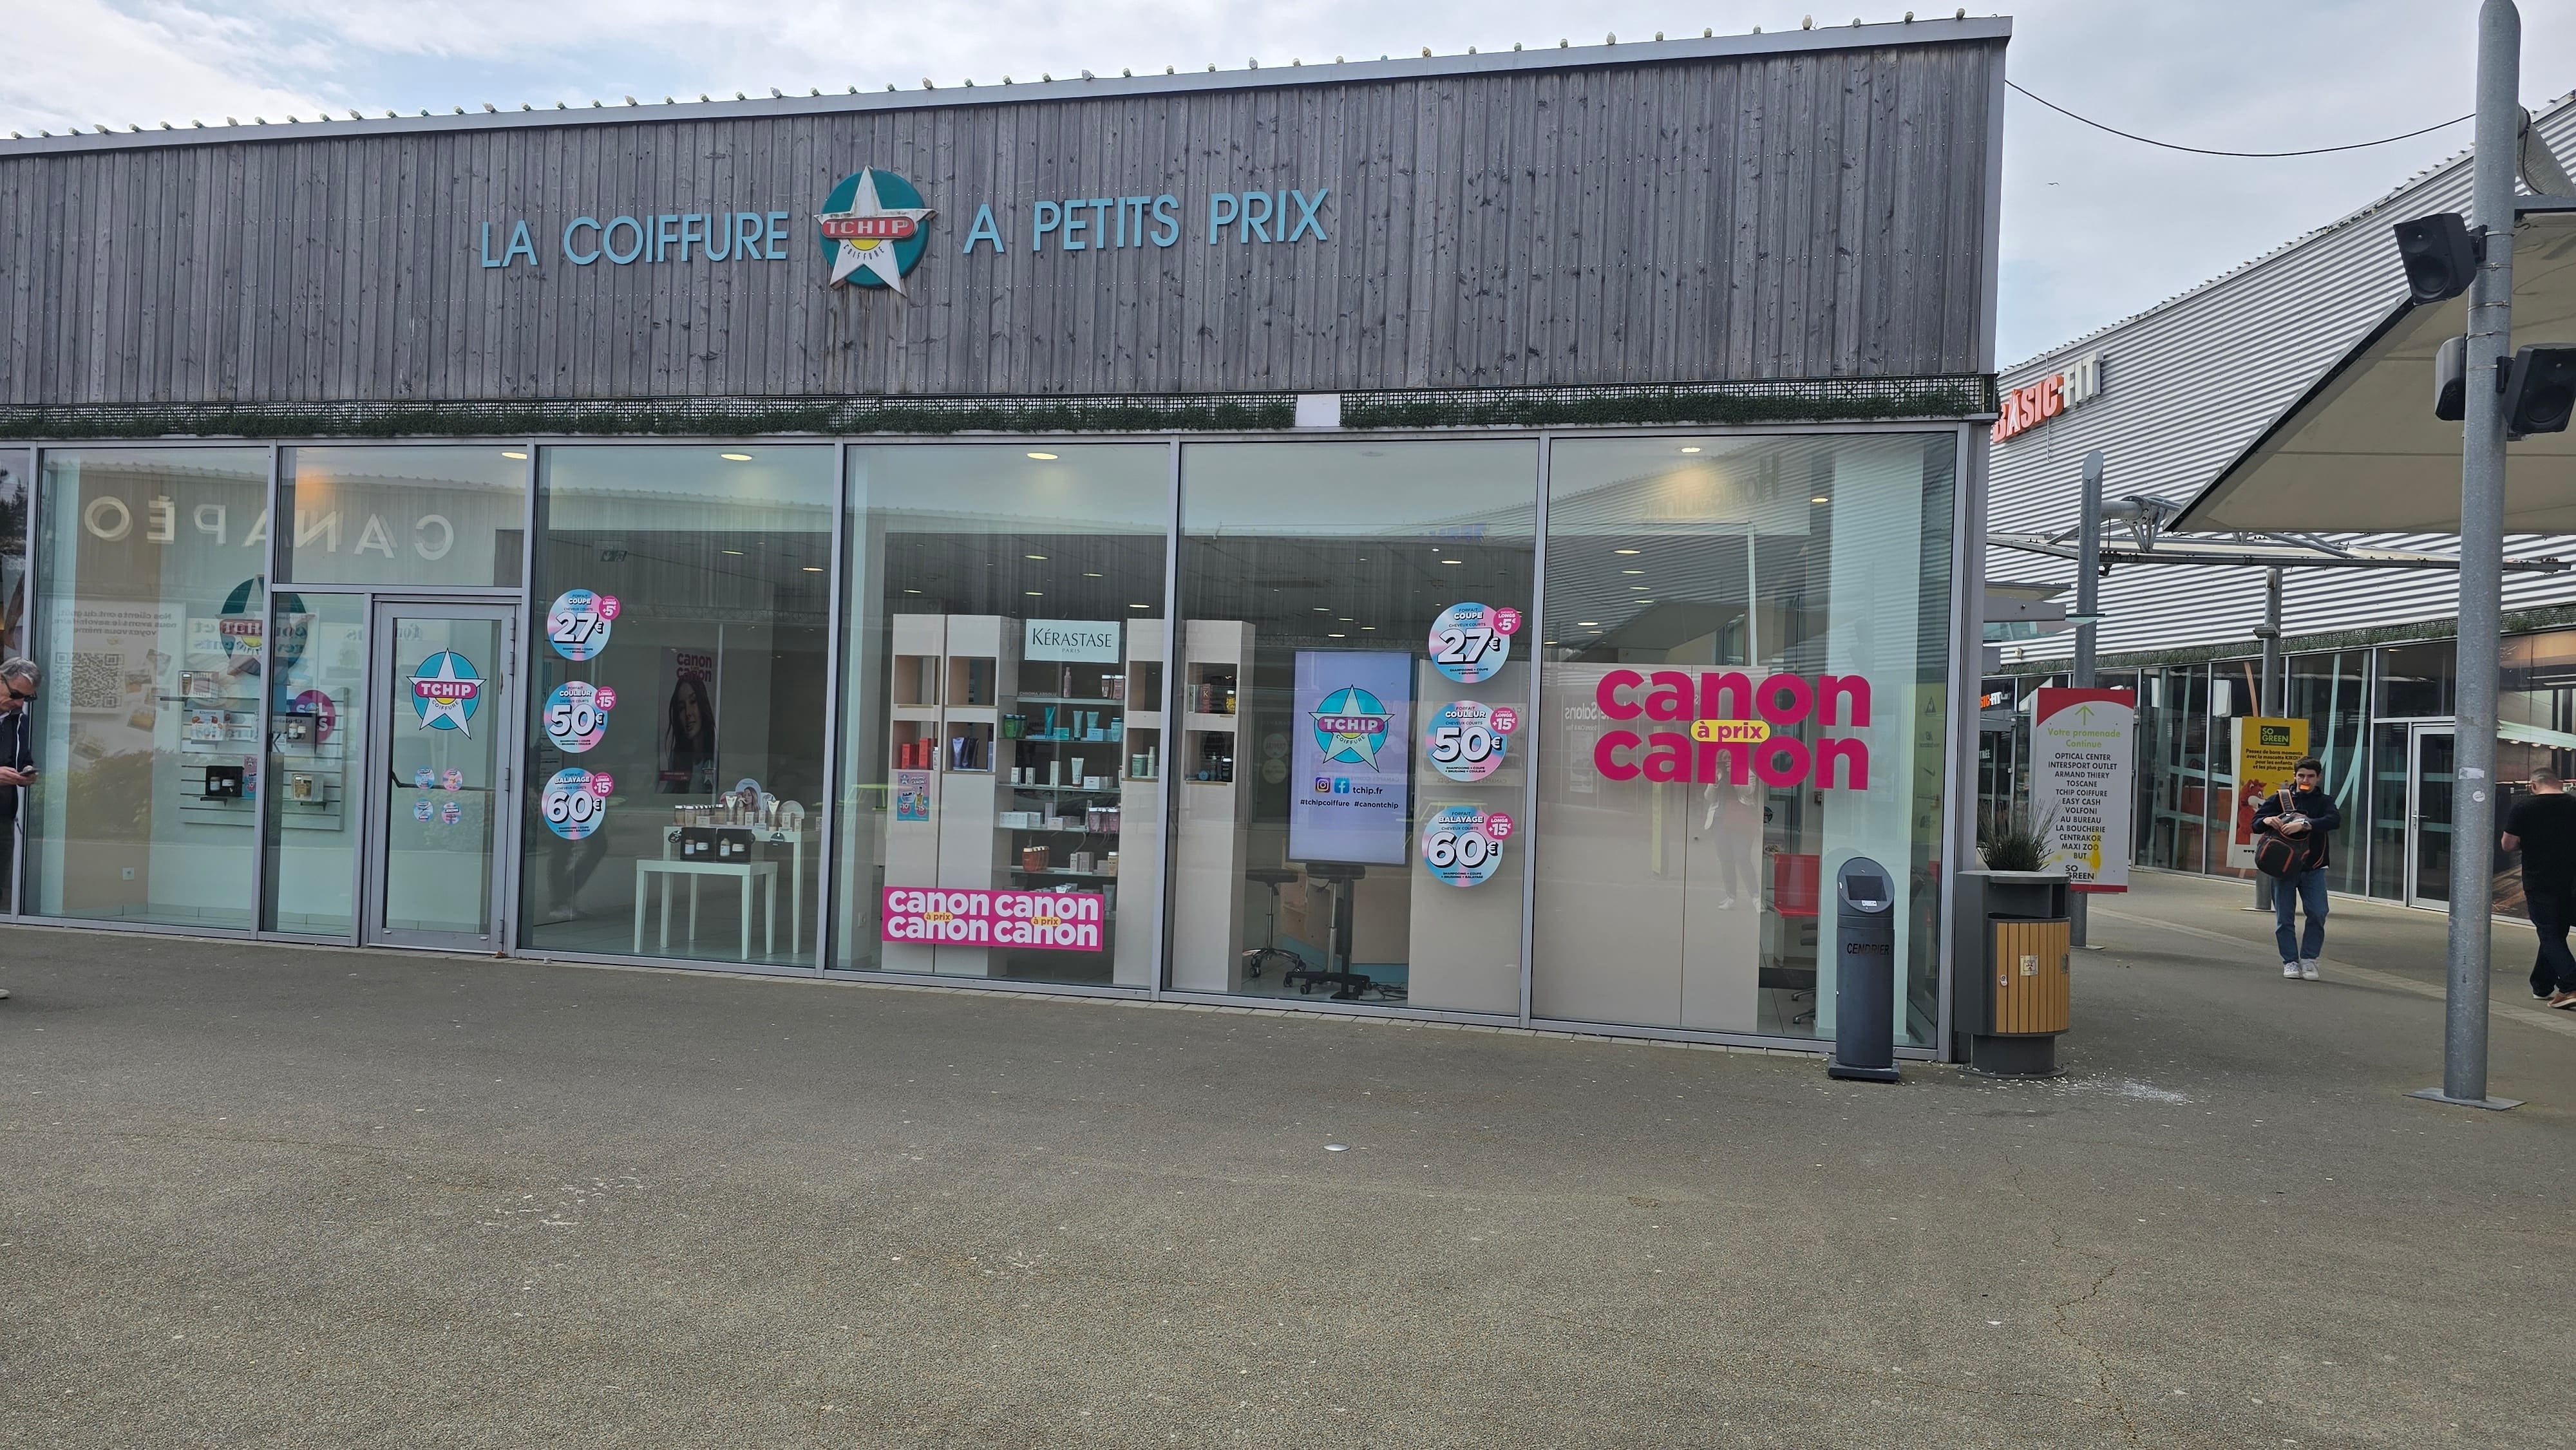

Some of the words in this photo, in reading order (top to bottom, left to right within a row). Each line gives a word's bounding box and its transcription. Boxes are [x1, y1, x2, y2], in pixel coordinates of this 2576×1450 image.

[482, 219, 538, 268] LA
[564, 211, 788, 265] COIFFURE
[963, 204, 1005, 254] A
[1033, 194, 1180, 251] PETITS
[1209, 188, 1329, 245] PRIX
[827, 220, 909, 234] TCHIP
[843, 244, 885, 261] COIFFURE
[1993, 352, 2104, 444] BASIC-FIT
[1454, 612, 1484, 620] COUPE
[1032, 628, 1112, 648] KÉRASTASE
[1437, 628, 1501, 664] 27€
[677, 653, 712, 668] canon
[421, 683, 471, 696] TCHIP
[432, 700, 459, 711] COIFFURE
[1596, 670, 1871, 727] canon
[1324, 719, 1378, 731] TCHIP
[1696, 720, 1710, 739] à
[1718, 721, 1763, 742] prix
[1336, 735, 1366, 745] COIFFURE
[2048, 728, 2070, 736] Votre
[2072, 729, 2121, 738] promenade
[1432, 726, 1503, 762] 50€
[2066, 739, 2102, 748] Continue
[1594, 730, 1869, 791] canon
[2048, 761, 2090, 769] INTERSPORT
[1352, 787, 1383, 795] tchip.fr
[1300, 799, 1350, 807] #tchipcoiffure
[1354, 801, 1399, 809] #canontchip
[2060, 834, 2102, 842] CENTRAKOR
[1427, 831, 1499, 868] 60€
[888, 890, 990, 916] canon
[994, 894, 1099, 921] canon
[933, 913, 951, 922] prix
[1033, 917, 1039, 925] à
[1041, 918, 1059, 927] prix
[887, 916, 989, 942] canon
[994, 920, 1097, 946] canon
[1846, 943, 1890, 956] CENDRIER
